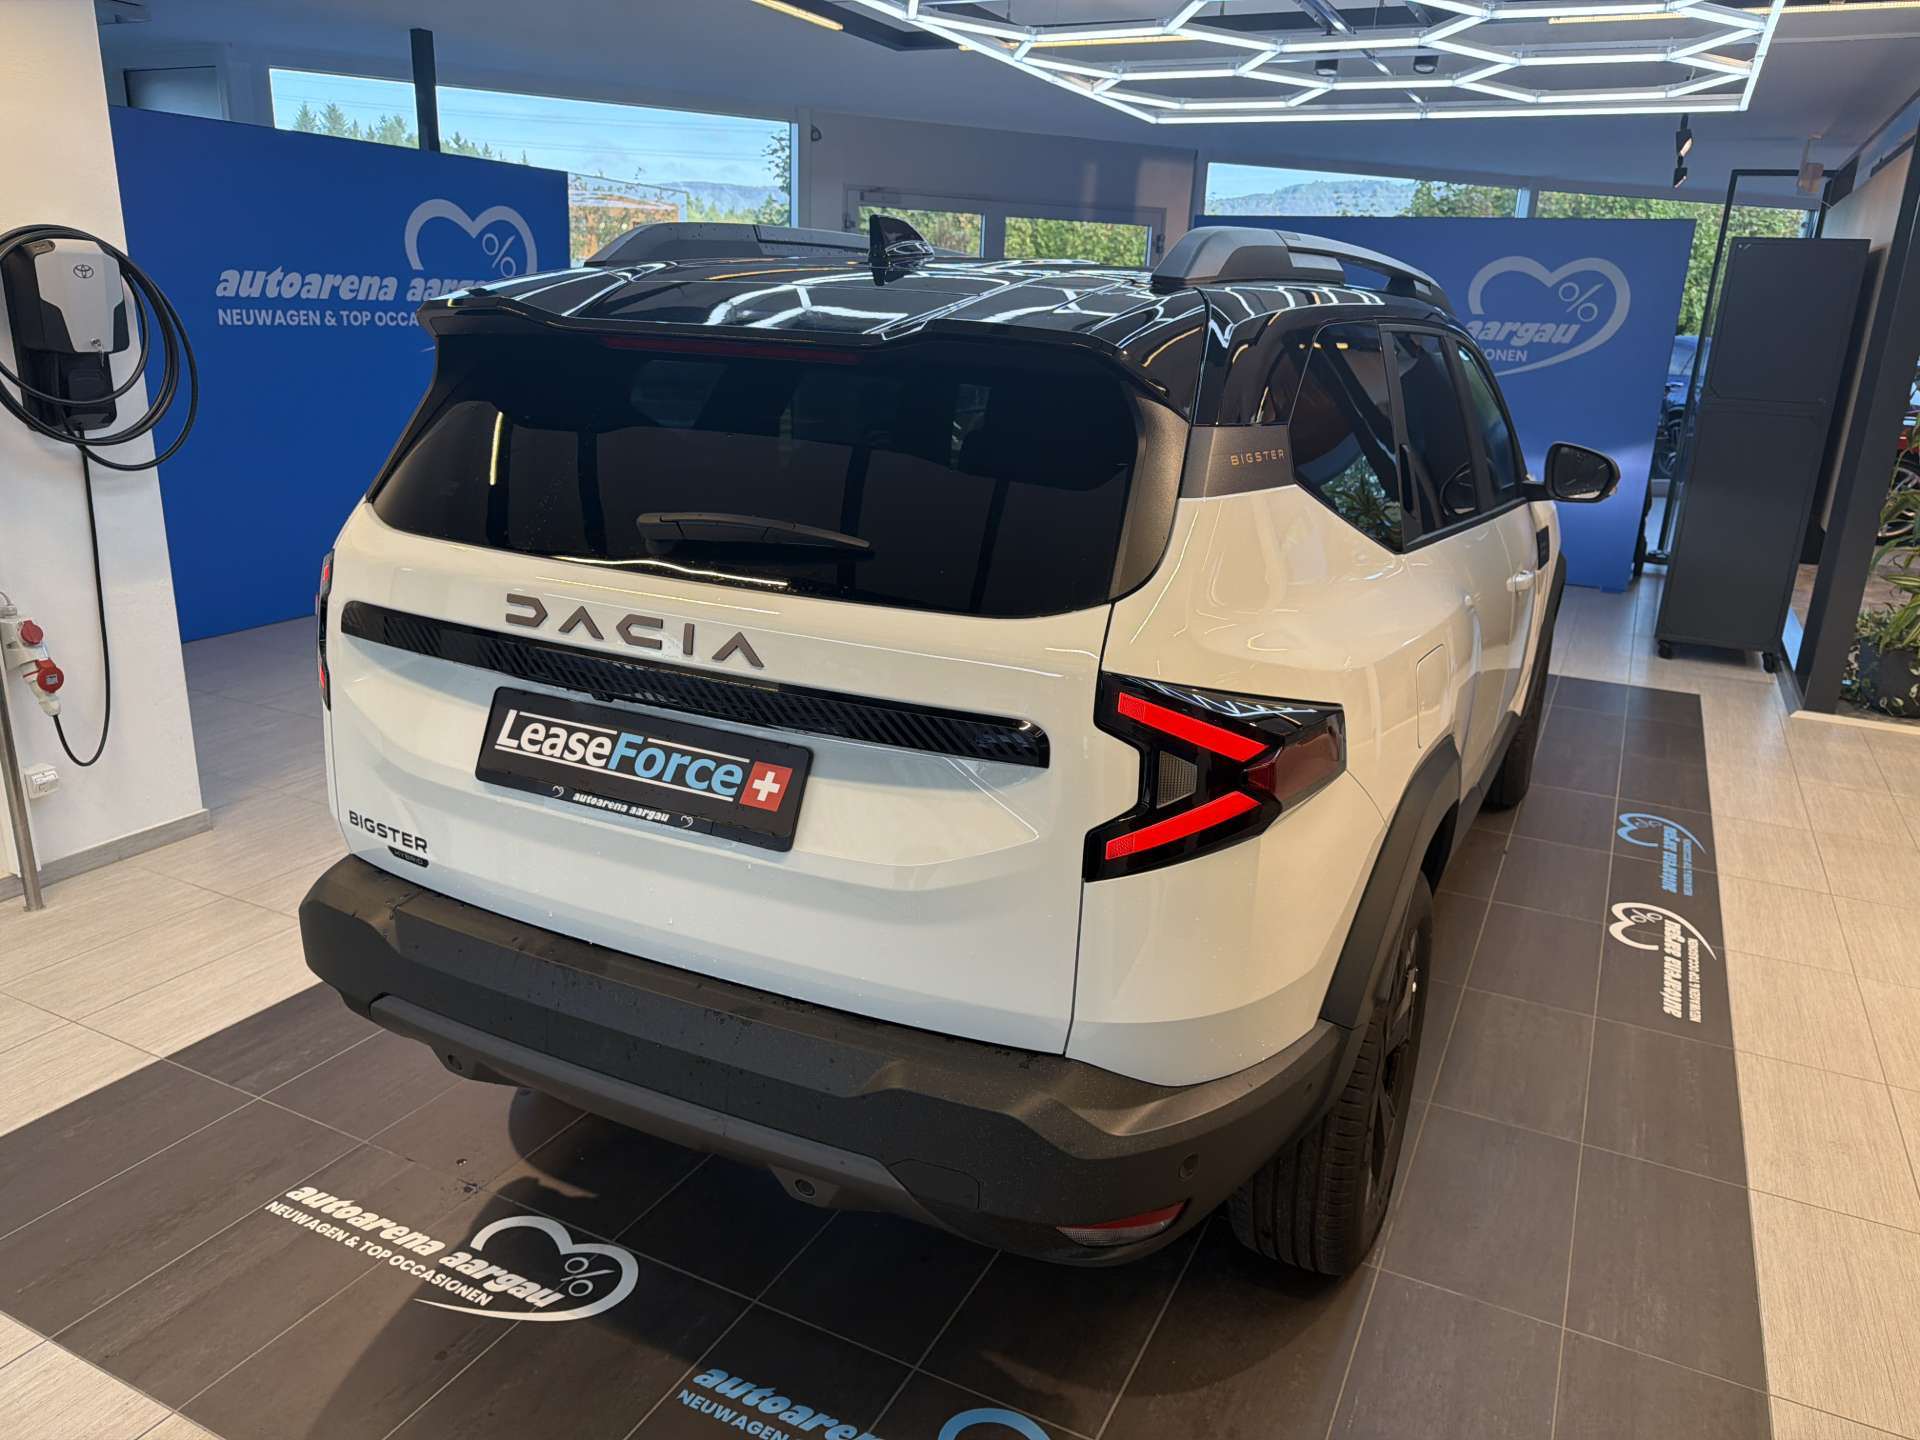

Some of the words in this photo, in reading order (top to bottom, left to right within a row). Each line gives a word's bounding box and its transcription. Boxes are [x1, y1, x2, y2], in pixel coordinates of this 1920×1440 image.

[216, 265, 398, 301] autoarena
[218, 309, 321, 327] NEUWAGEN
[324, 310, 337, 327] &
[340, 311, 371, 327] TOP
[375, 312, 419, 327] OCCA
[1481, 348, 1528, 362] ONEN
[1230, 449, 1285, 466] BIGSTER
[505, 593, 765, 668] DACIA
[496, 709, 743, 797] LeaseForce
[573, 792, 628, 813] autoarena
[629, 805, 670, 822] aargau
[349, 809, 428, 854] BIGSTER
[1659, 956, 1683, 1019] autoarena
[265, 1201, 351, 1247] NEUWAGEN
[363, 1240, 393, 1260] TOP
[389, 1255, 495, 1307] OCCASIONEN
[286, 1186, 446, 1256] autoarena
[439, 1250, 565, 1308] aargau
